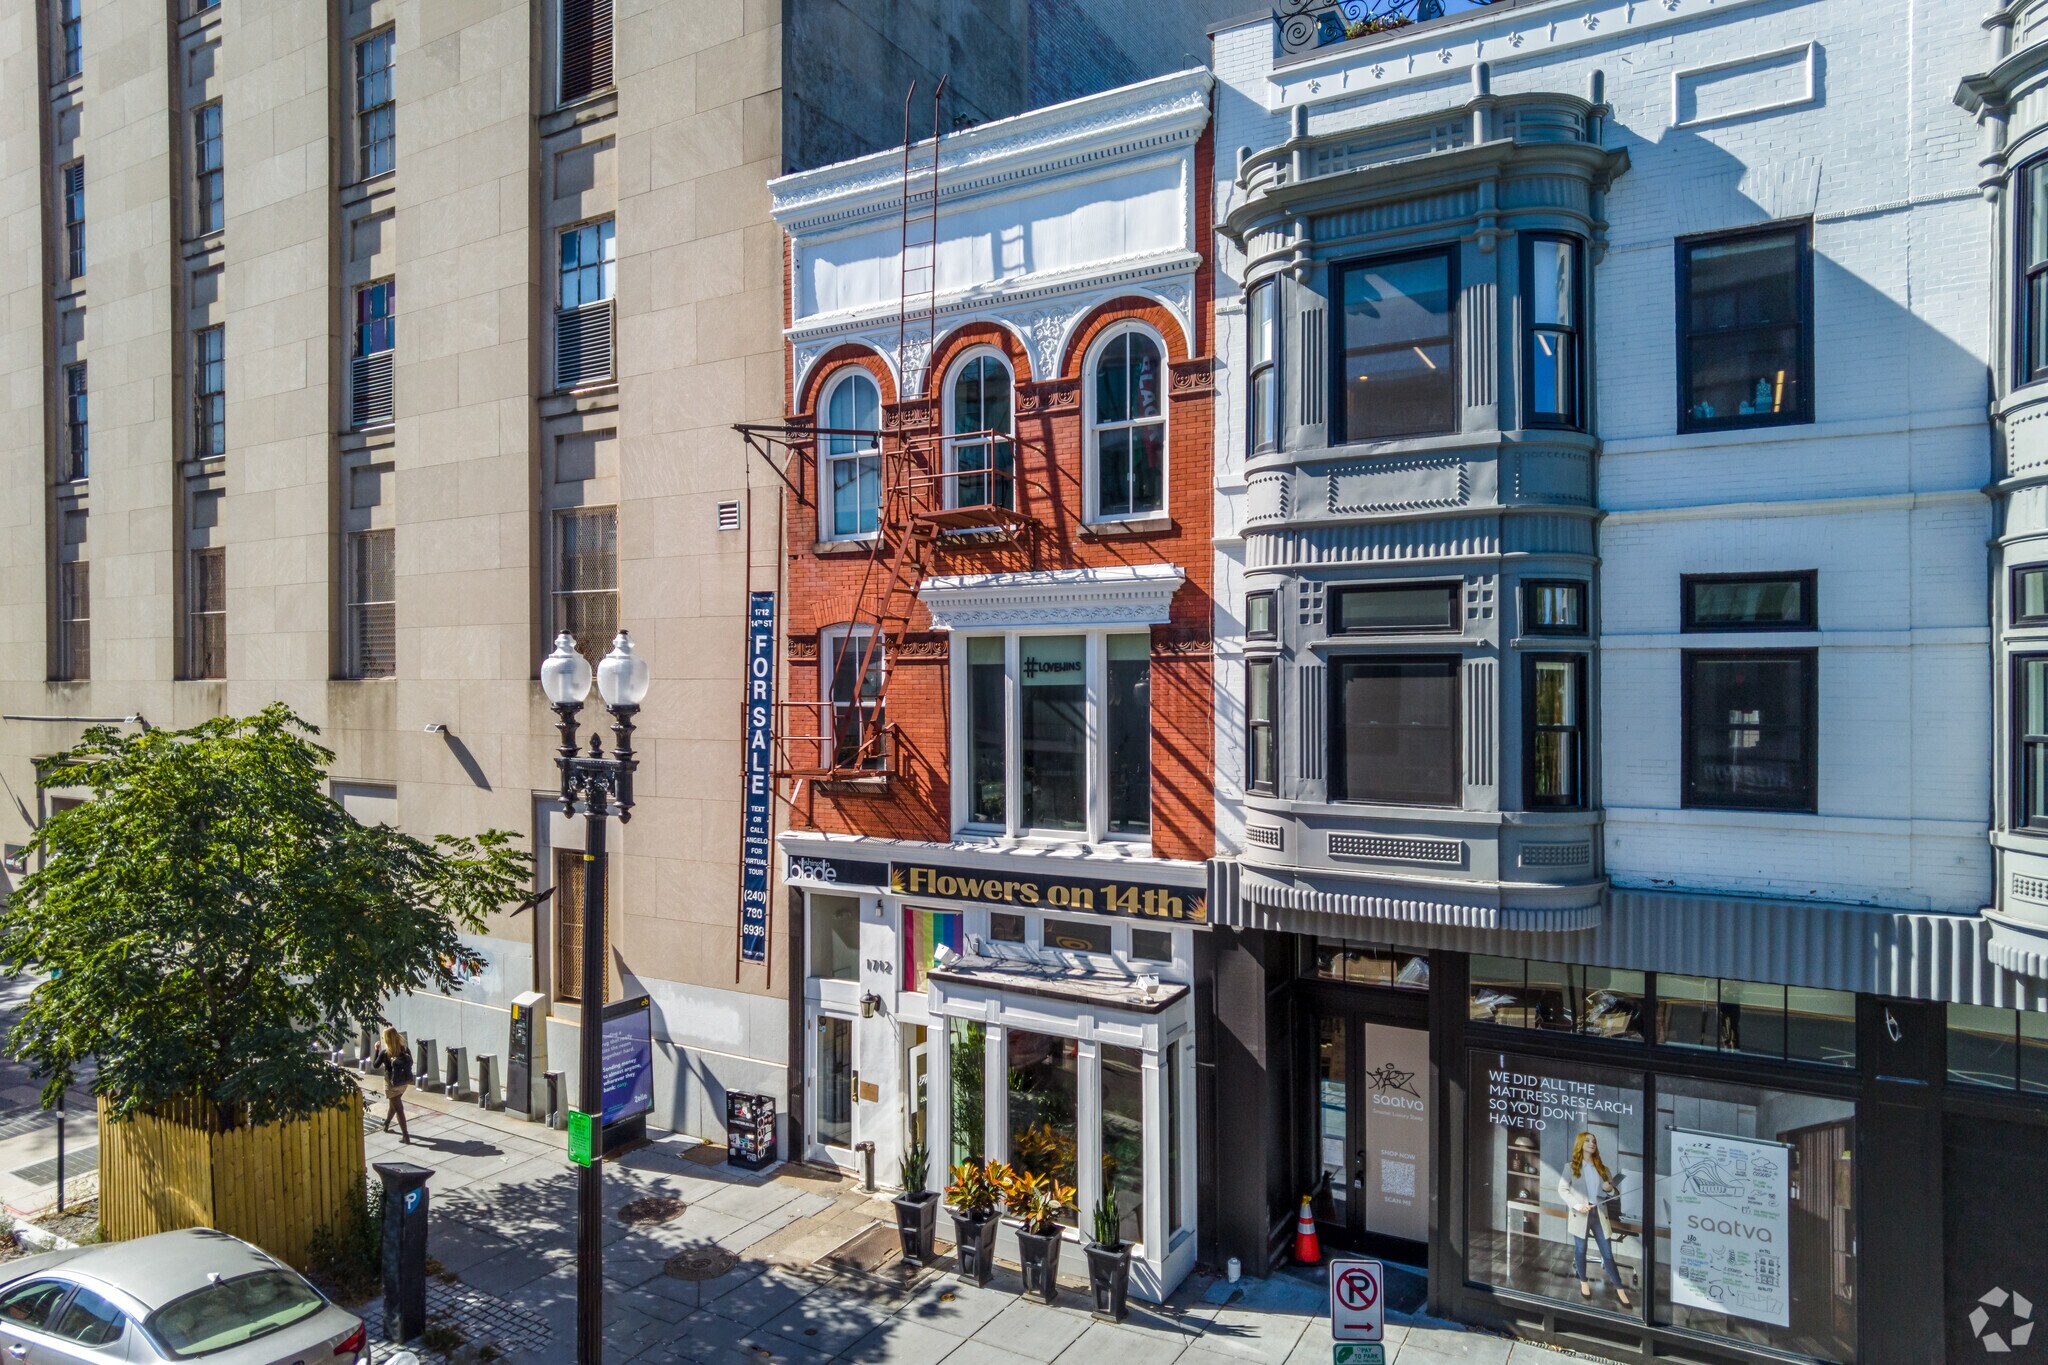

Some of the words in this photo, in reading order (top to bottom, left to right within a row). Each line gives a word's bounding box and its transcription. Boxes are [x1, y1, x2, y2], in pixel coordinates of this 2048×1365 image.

[754, 608, 770, 616] 1712
[764, 620, 772, 628] ST
[753, 635, 768, 700] FOR
[752, 706, 766, 794] SALE
[750, 826, 764, 834] CALL
[745, 858, 768, 866] VIRTUAL
[790, 856, 837, 882] blade
[748, 868, 764, 876] TOUR
[744, 890, 766, 904] (240)
[909, 867, 1040, 903] Flowers
[1047, 885, 1094, 909] on
[1100, 884, 1183, 918] 14th
[746, 908, 762, 918] 780
[866, 959, 893, 975] 1712
[1489, 1070, 1510, 1084] WE
[1514, 1074, 1538, 1087] DID
[1540, 1077, 1566, 1091] ALL
[1568, 1081, 1595, 1095] THE
[1373, 1094, 1424, 1111] saatva
[1489, 1084, 1558, 1104] MATTRESS
[1562, 1095, 1633, 1115] RESEARCH
[1489, 1099, 1507, 1110] SO
[1509, 1101, 1539, 1116] YOU
[1543, 1106, 1587, 1123] DON'T
[1489, 1113, 1524, 1128] HAVE
[1527, 1118, 1546, 1131] TO
[1381, 1149, 1398, 1157] SHOP
[1400, 1152, 1416, 1160] NOW
[1384, 1196, 1402, 1204] SCAN
[1688, 1215, 1772, 1243] saatva
